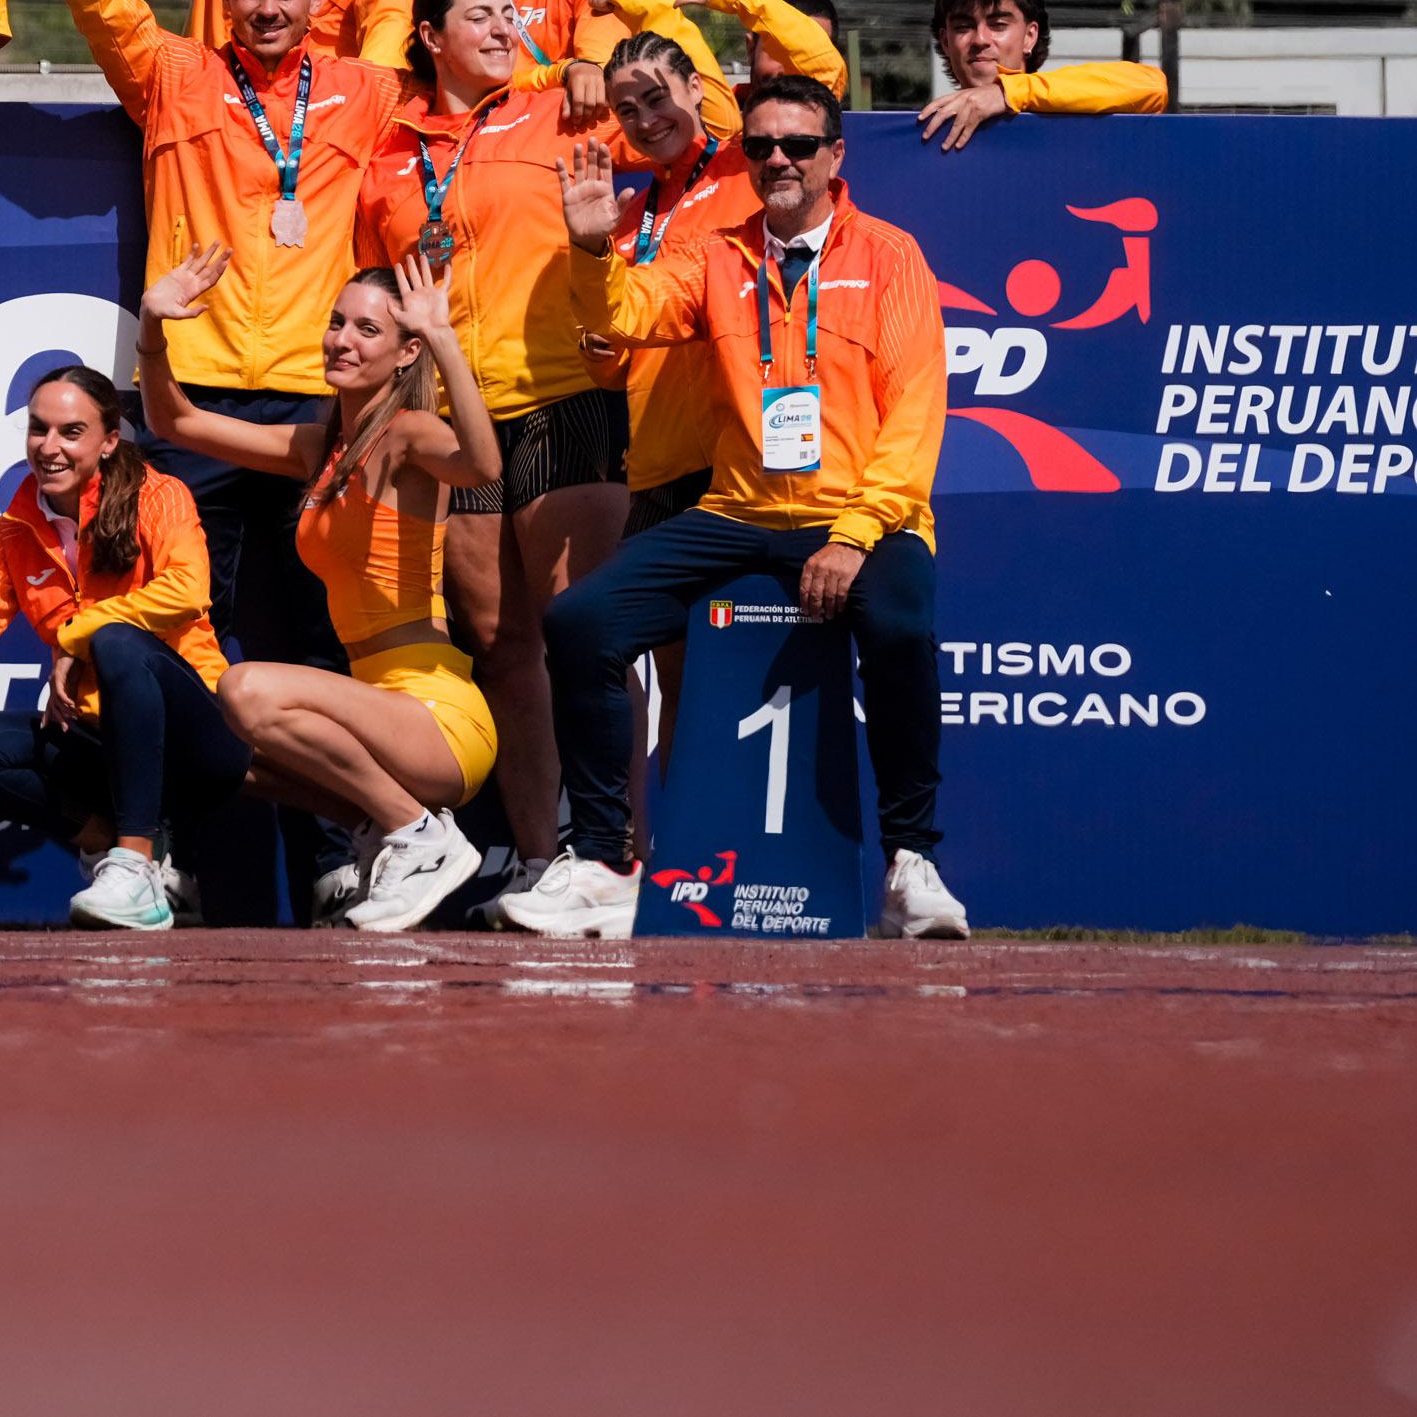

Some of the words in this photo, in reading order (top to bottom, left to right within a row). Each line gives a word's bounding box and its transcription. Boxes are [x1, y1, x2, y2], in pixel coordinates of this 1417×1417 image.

[1155, 384, 1417, 435] PERUAN
[1154, 443, 1272, 494] DEL
[1287, 443, 1417, 494] DEP
[734, 604, 783, 614] FEDERACIÓN
[734, 615, 771, 623] PERUANA
[737, 685, 792, 834] 1
[670, 881, 710, 903] IPD
[733, 883, 810, 902] INSTITUTO
[732, 899, 805, 917] PERUANO
[730, 913, 759, 930] DEL
[762, 915, 832, 934] DEPORTE
